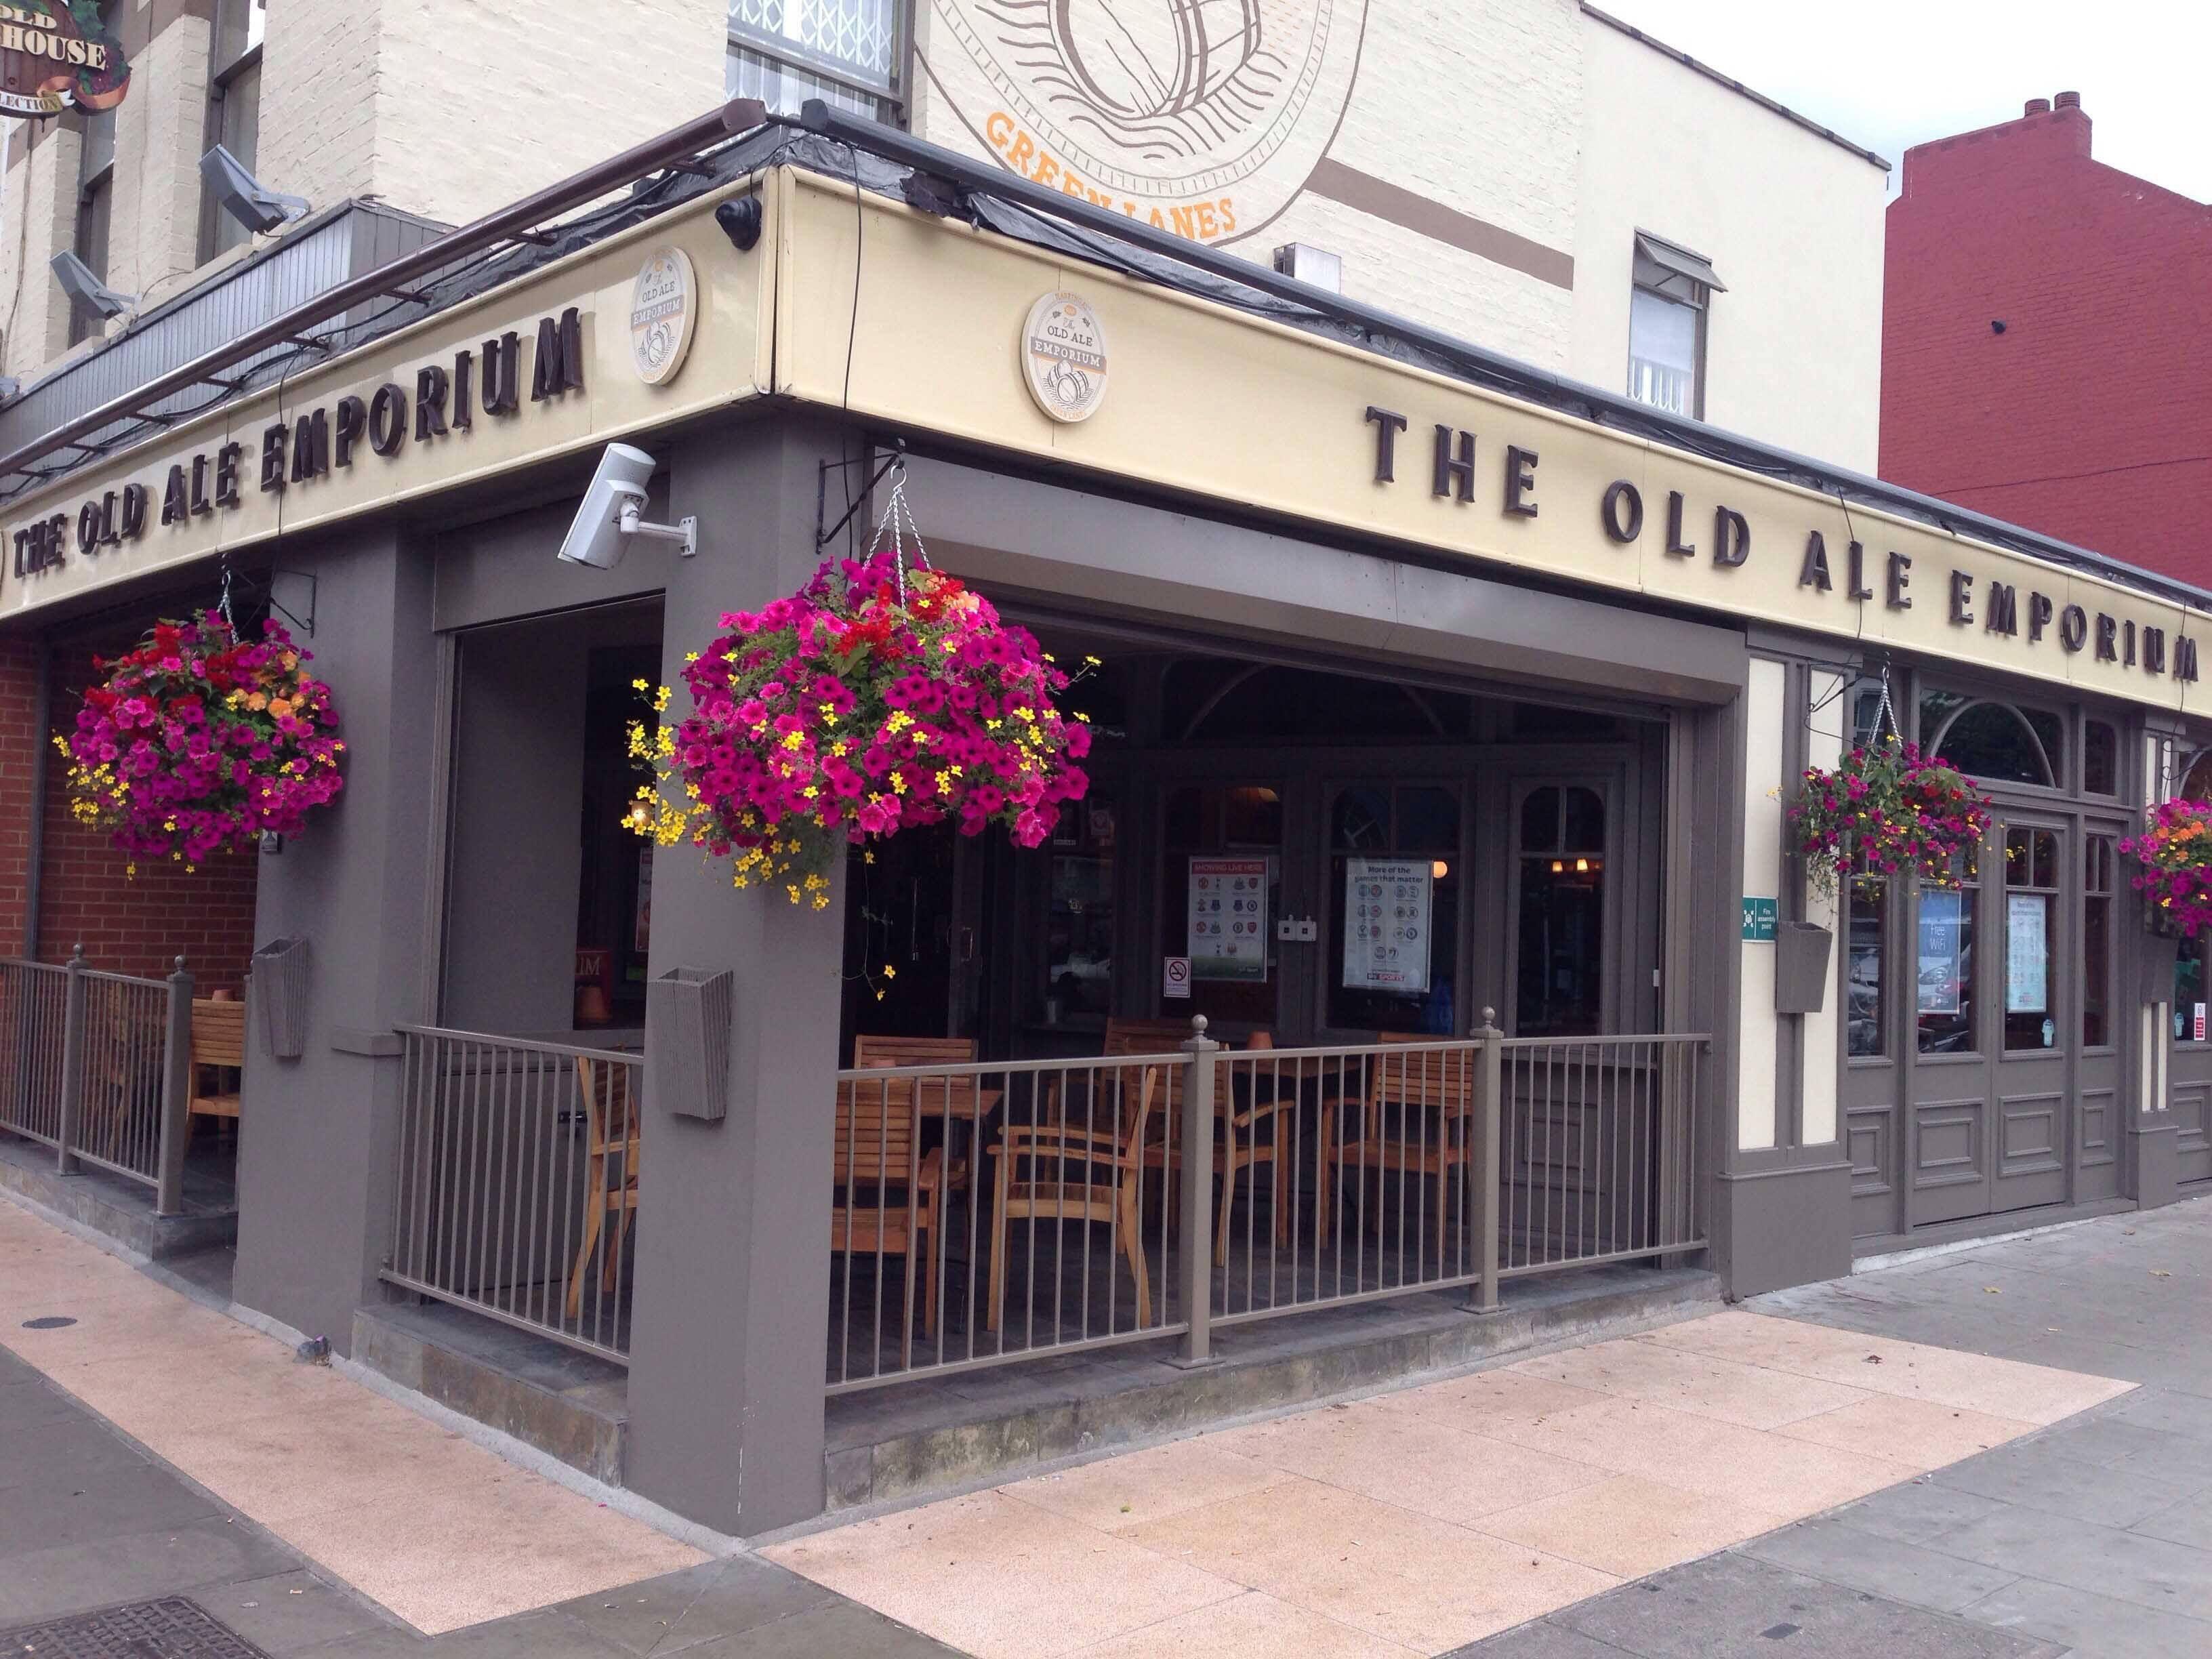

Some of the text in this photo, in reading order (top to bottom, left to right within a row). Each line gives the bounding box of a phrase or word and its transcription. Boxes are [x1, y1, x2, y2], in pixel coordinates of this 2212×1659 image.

[0, 24, 106, 70] HOUSE
[642, 281, 675, 303] OLD ALE
[633, 299, 680, 325] EMPORIUM
[1047, 325, 1093, 347] OLD ALE
[1035, 341, 1101, 367] EMPORIUM
[14, 306, 584, 578] THE OLD ALE EMPORIUM
[1365, 405, 2199, 682] THE OLD ALE EMPORIUM
[1930, 924, 1946, 936] Free
[1930, 938, 1946, 950] WiFi
